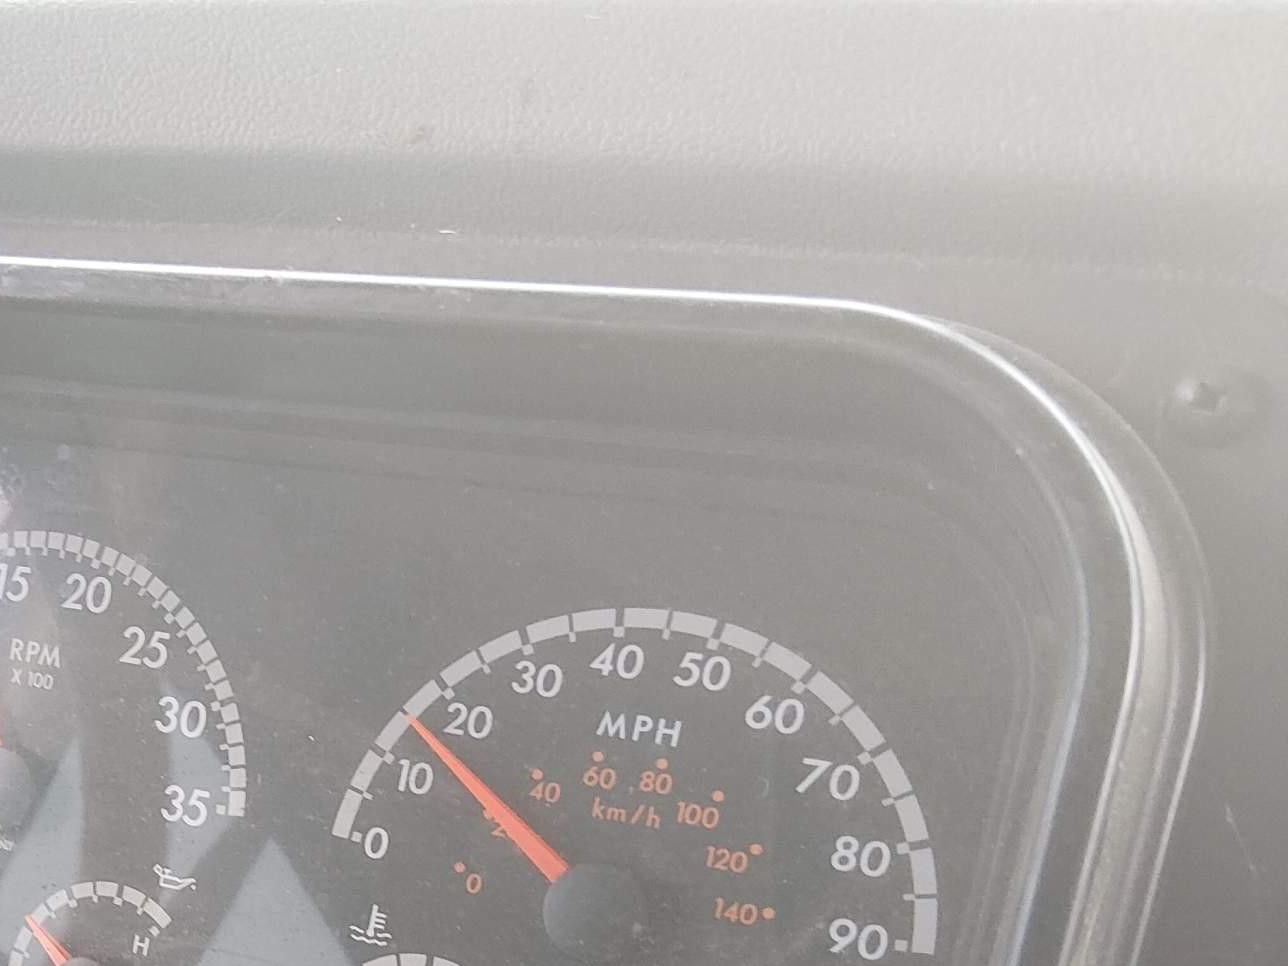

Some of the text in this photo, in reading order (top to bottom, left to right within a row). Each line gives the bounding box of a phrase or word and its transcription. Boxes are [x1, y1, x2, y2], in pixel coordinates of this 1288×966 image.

[61, 573, 112, 614] 20
[10, 638, 61, 669] RPM
[119, 626, 171, 669] 25
[589, 643, 644, 681] 40
[26, 671, 54, 691] 100
[512, 661, 563, 699] 30
[673, 652, 731, 692] 50
[154, 696, 207, 738] 30
[443, 702, 494, 740] 20
[596, 710, 682, 747] MPH
[744, 694, 806, 736] 60
[397, 758, 434, 795] 10
[528, 782, 561, 803] 40
[583, 767, 617, 790] 60
[640, 771, 673, 795] 80
[795, 757, 861, 801] 70
[160, 785, 210, 827] 35
[592, 797, 661, 829] km/h
[676, 801, 719, 829] 100
[363, 826, 389, 860] 0
[705, 846, 748, 874] 120
[830, 836, 890, 878] 80
[465, 873, 483, 894] 0
[714, 897, 758, 925] 140
[132, 935, 150, 957] H
[828, 918, 889, 962] 90
